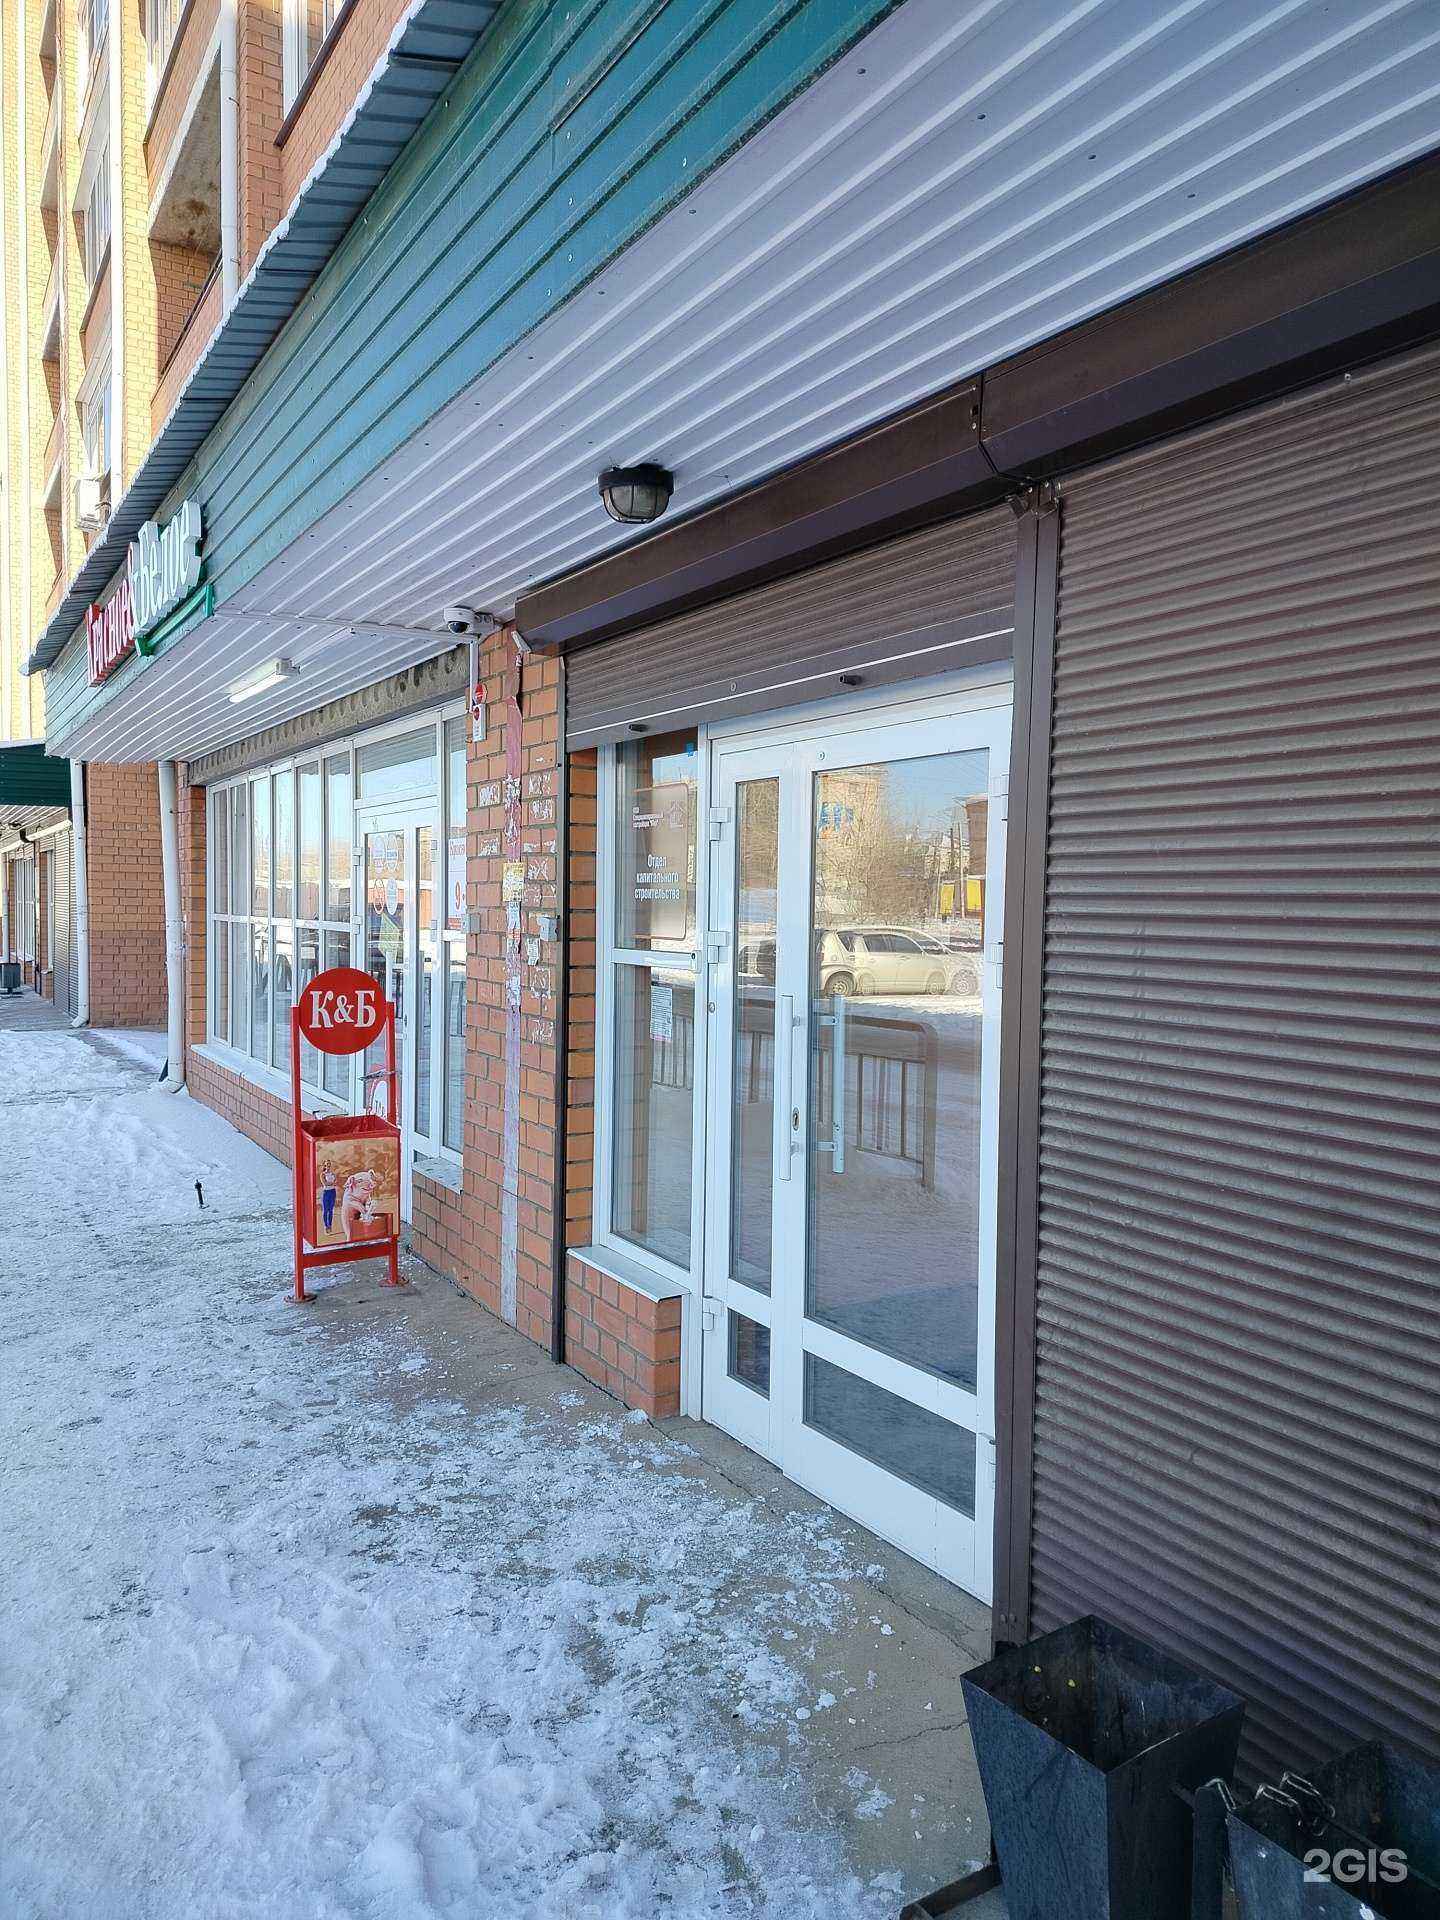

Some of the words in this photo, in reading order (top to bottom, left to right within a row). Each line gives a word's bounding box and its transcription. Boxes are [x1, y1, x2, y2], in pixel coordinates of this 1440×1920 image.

[647, 853, 666, 869] Отдел
[636, 872, 678, 883] капитального
[634, 887, 680, 901] строительства
[309, 989, 377, 1030] К&Б
